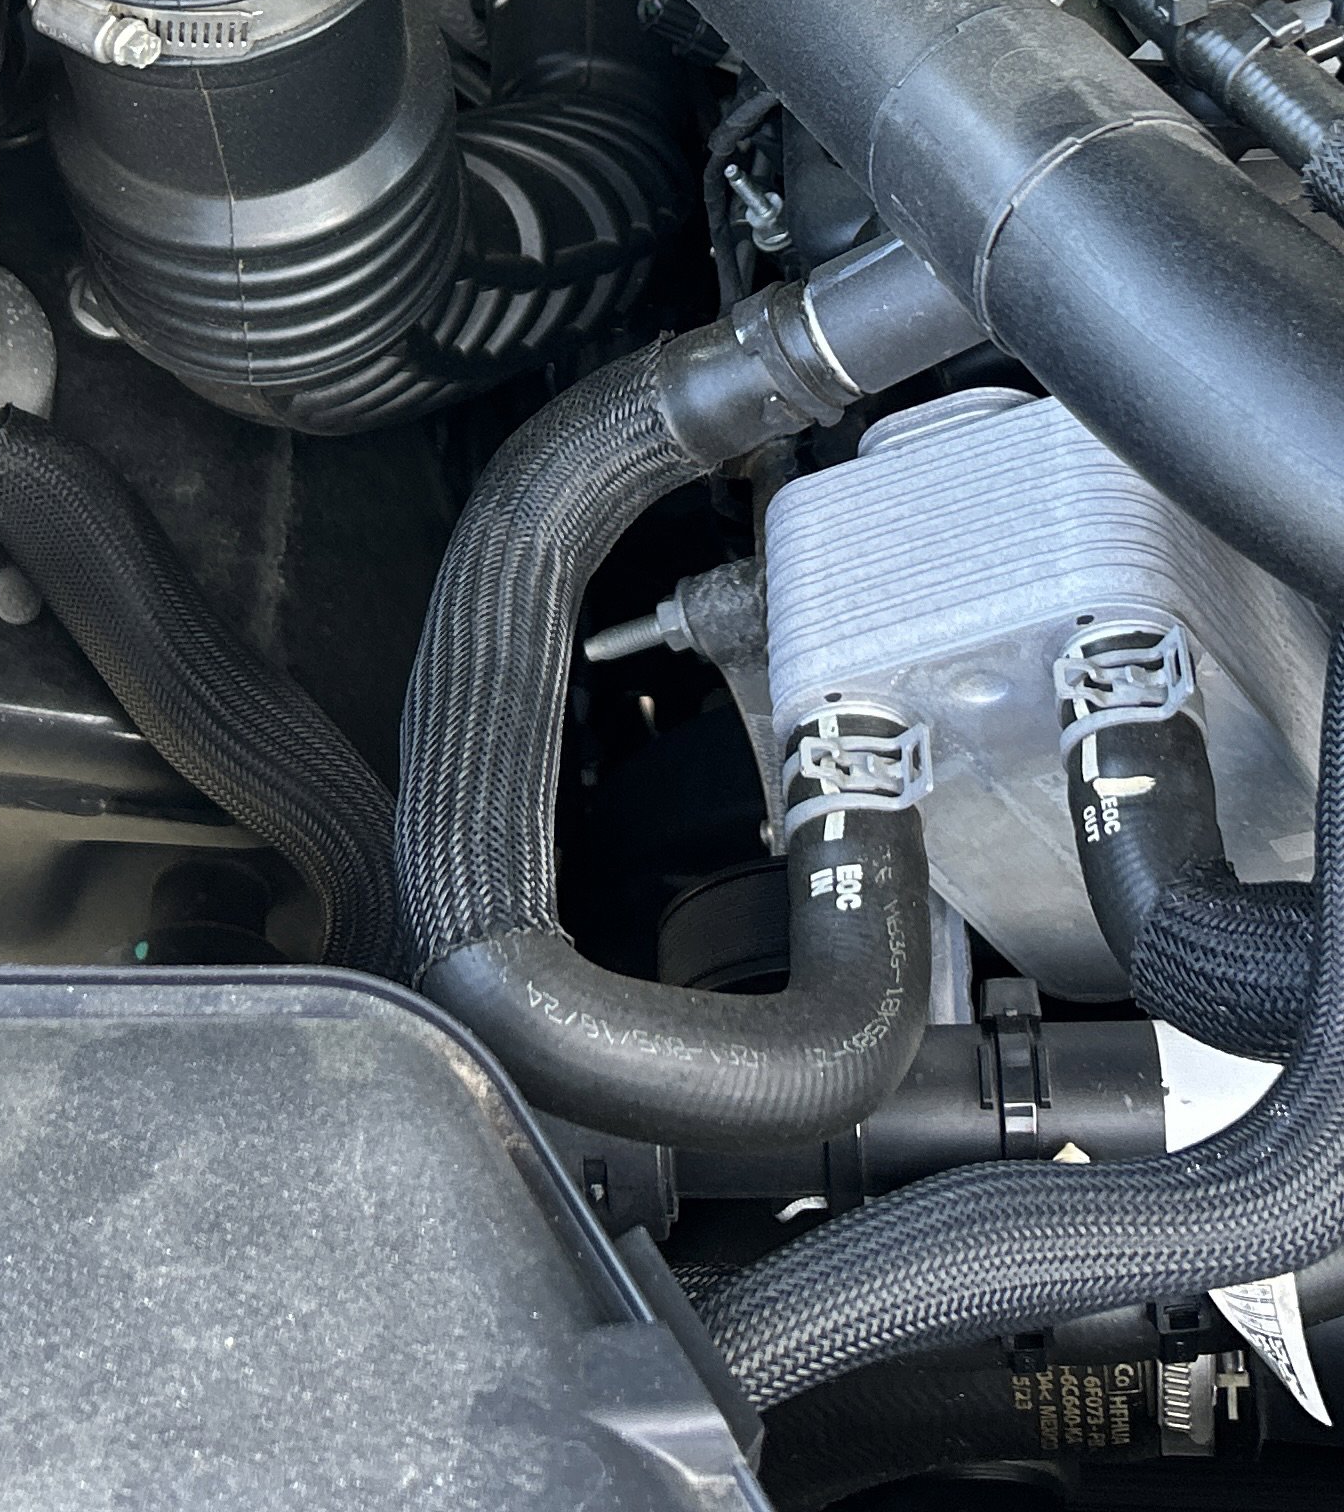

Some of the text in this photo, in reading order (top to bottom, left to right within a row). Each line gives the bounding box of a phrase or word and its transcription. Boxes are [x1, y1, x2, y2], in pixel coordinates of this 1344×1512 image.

[1083, 805, 1100, 843] OUT
[1101, 796, 1121, 836] EOC
[809, 868, 834, 898] IN
[836, 863, 863, 911] EOC
